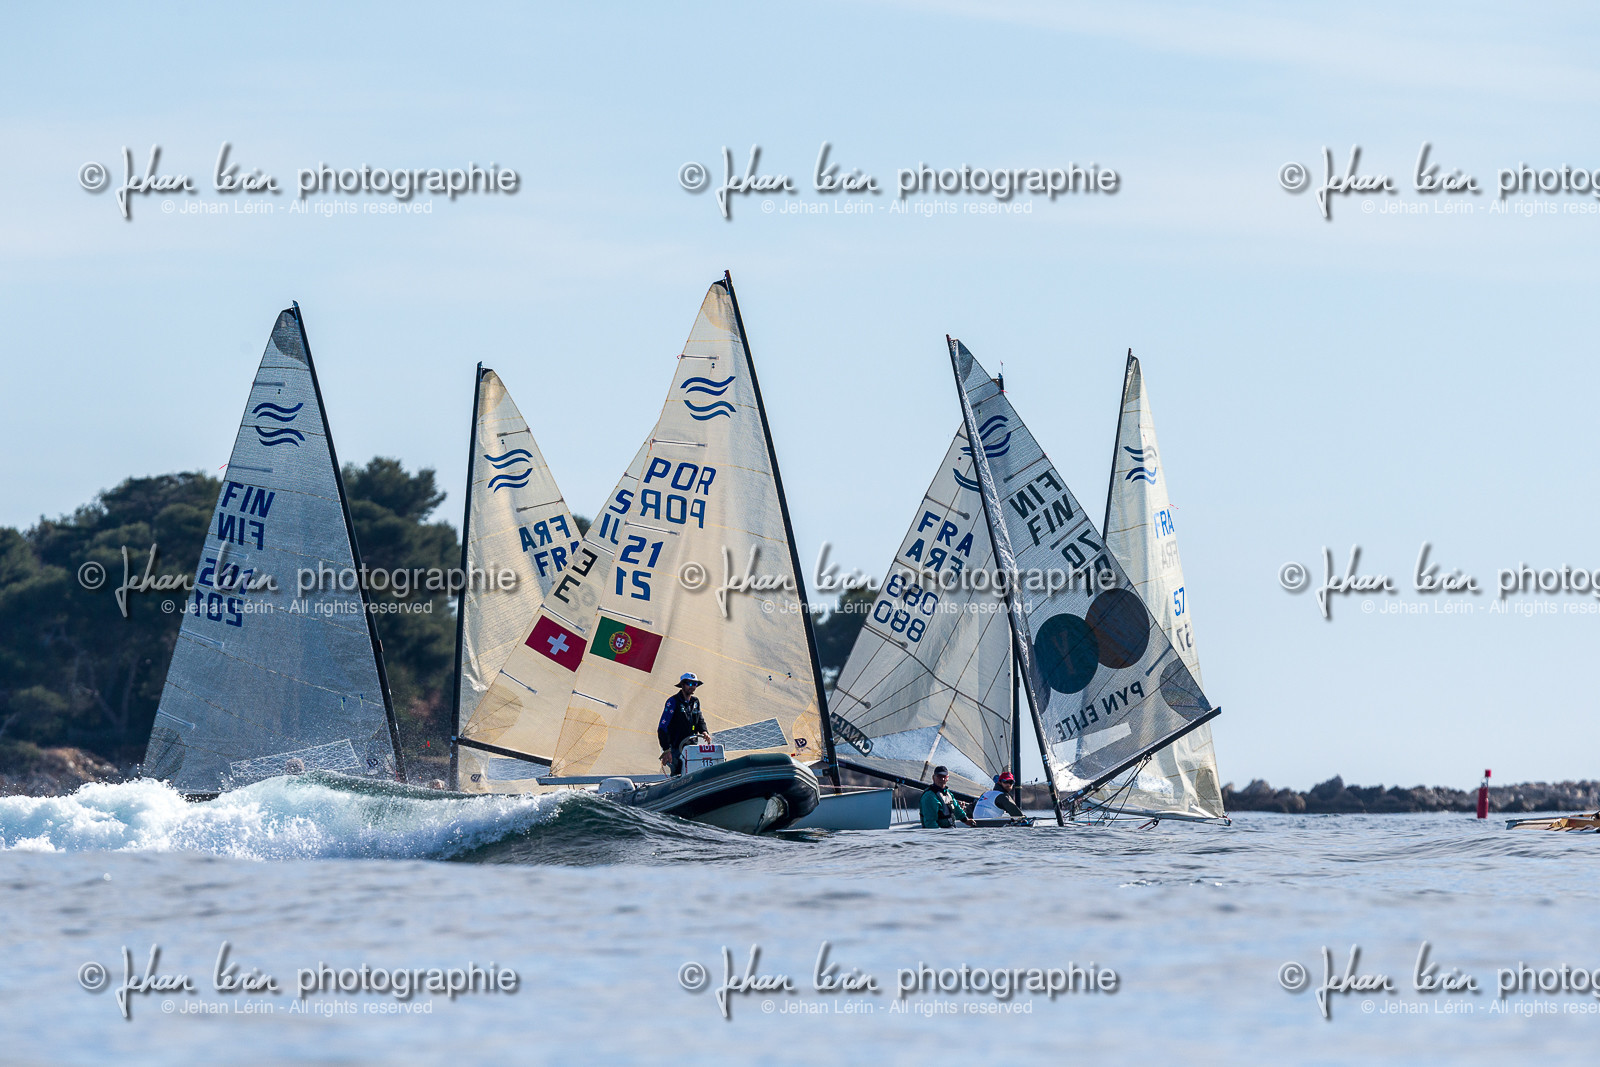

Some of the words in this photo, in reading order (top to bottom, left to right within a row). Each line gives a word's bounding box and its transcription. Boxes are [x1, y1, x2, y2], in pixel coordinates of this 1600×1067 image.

[643, 457, 717, 495] POR
[221, 481, 275, 518] FIN
[917, 510, 974, 557] FRA
[1027, 494, 1074, 547] FIN
[1153, 508, 1175, 539] FRA
[619, 535, 664, 568] 21
[886, 574, 939, 616] 880
[1173, 586, 1185, 617] 57
